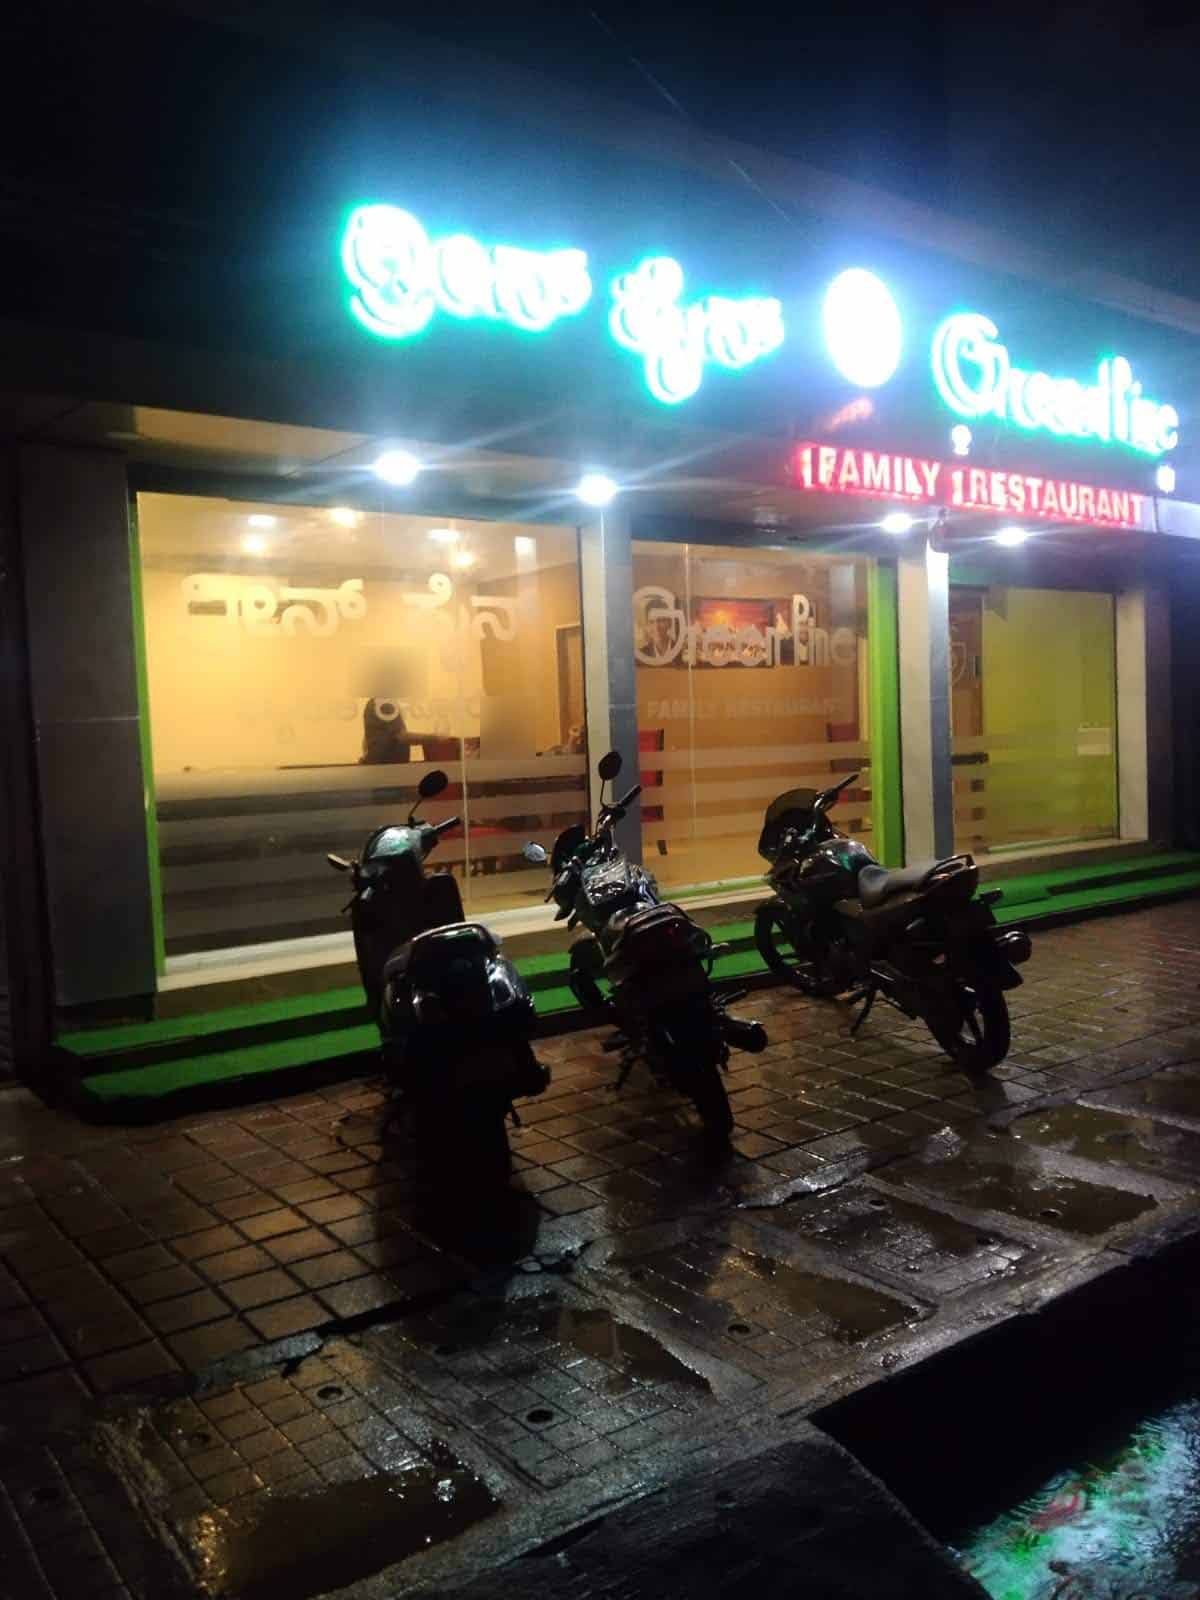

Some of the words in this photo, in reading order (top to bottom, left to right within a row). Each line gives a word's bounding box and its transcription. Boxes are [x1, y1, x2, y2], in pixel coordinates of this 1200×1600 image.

[802, 446, 941, 497] FAMILY
[953, 468, 1144, 524] RESTAURANT
[633, 586, 782, 667] Green
